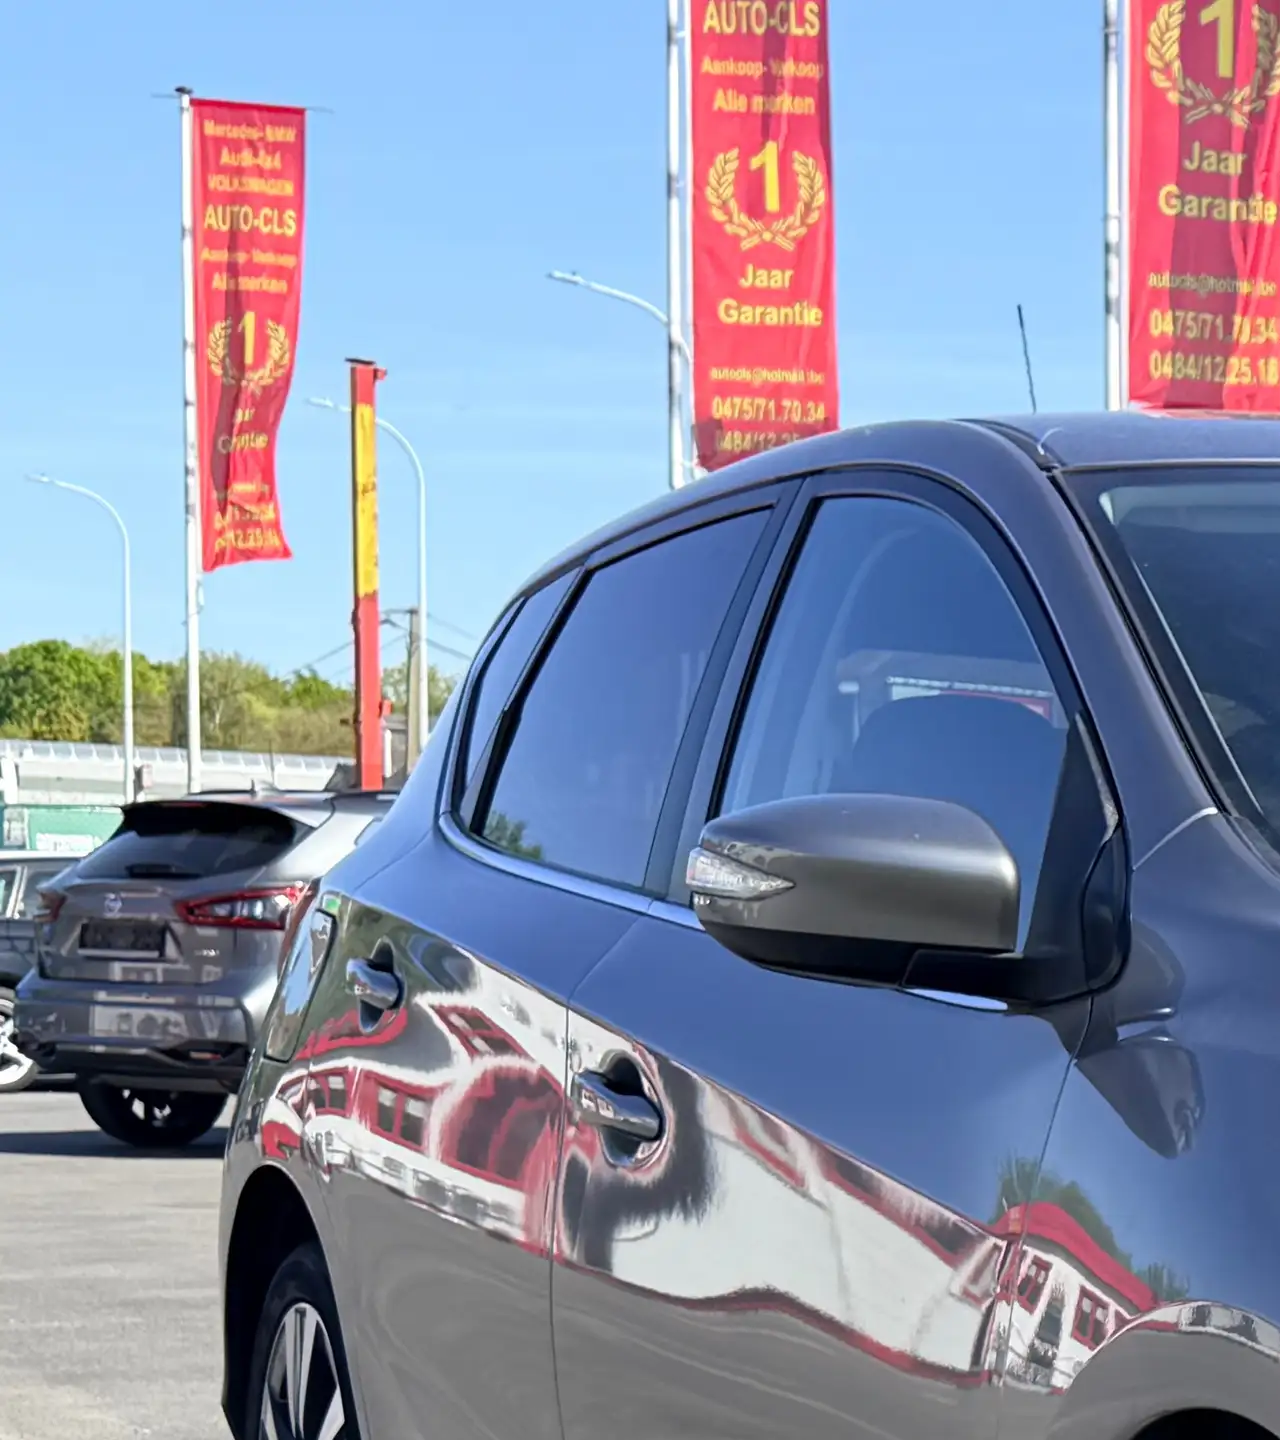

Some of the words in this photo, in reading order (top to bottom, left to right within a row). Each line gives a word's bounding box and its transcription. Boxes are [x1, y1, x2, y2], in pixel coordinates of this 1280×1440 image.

[703, 0, 820, 37] AUTO-CLS
[1200, 0, 1234, 78] 1
[713, 88, 748, 113] Alle
[752, 91, 815, 115] merken
[1183, 141, 1247, 175] Jaar
[750, 140, 780, 213] 1
[204, 204, 296, 237] AUTO-CLS
[1158, 184, 1277, 226] Garantie
[739, 263, 794, 289] Jaar
[718, 298, 823, 326] Garantie
[712, 396, 826, 422] 0475/71.70.34
